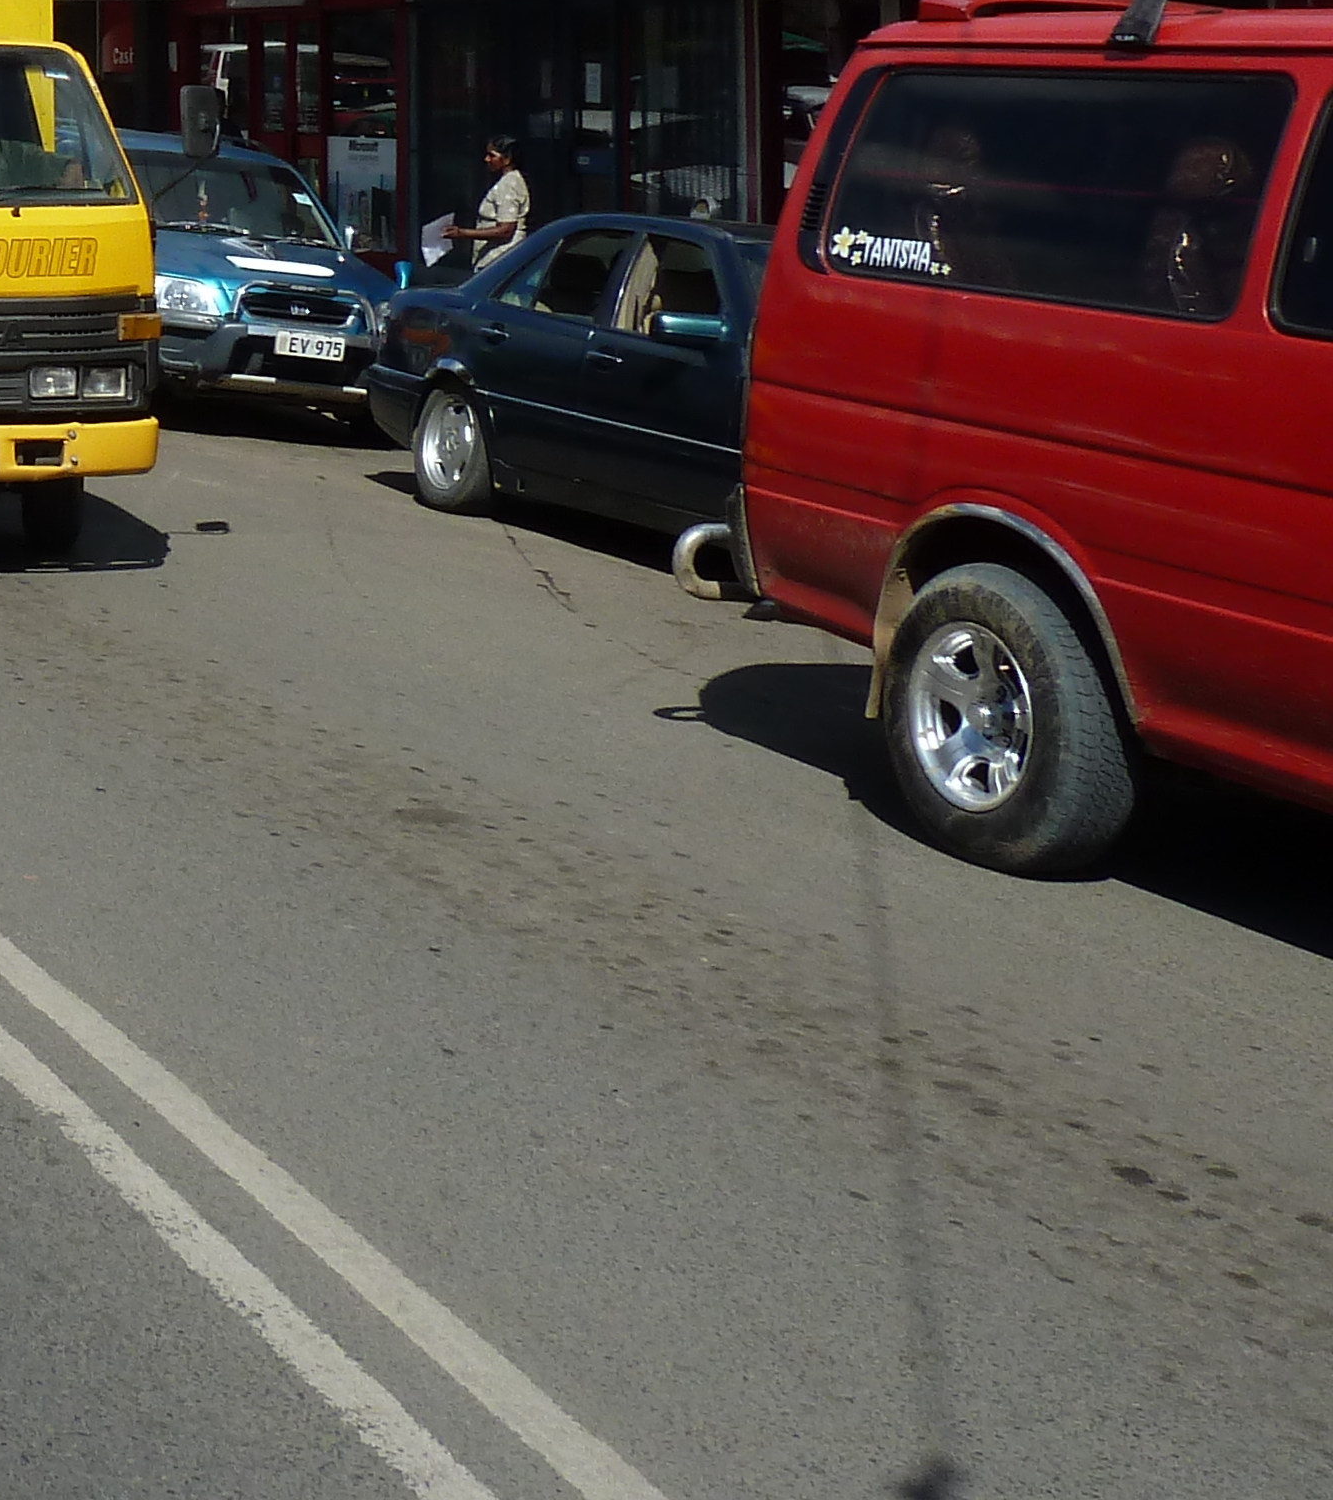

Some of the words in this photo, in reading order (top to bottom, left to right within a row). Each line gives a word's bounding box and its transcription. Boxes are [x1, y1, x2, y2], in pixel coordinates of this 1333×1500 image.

[863, 236, 932, 271] TANISHA
[289, 337, 310, 355] EV
[317, 339, 343, 359] 975
